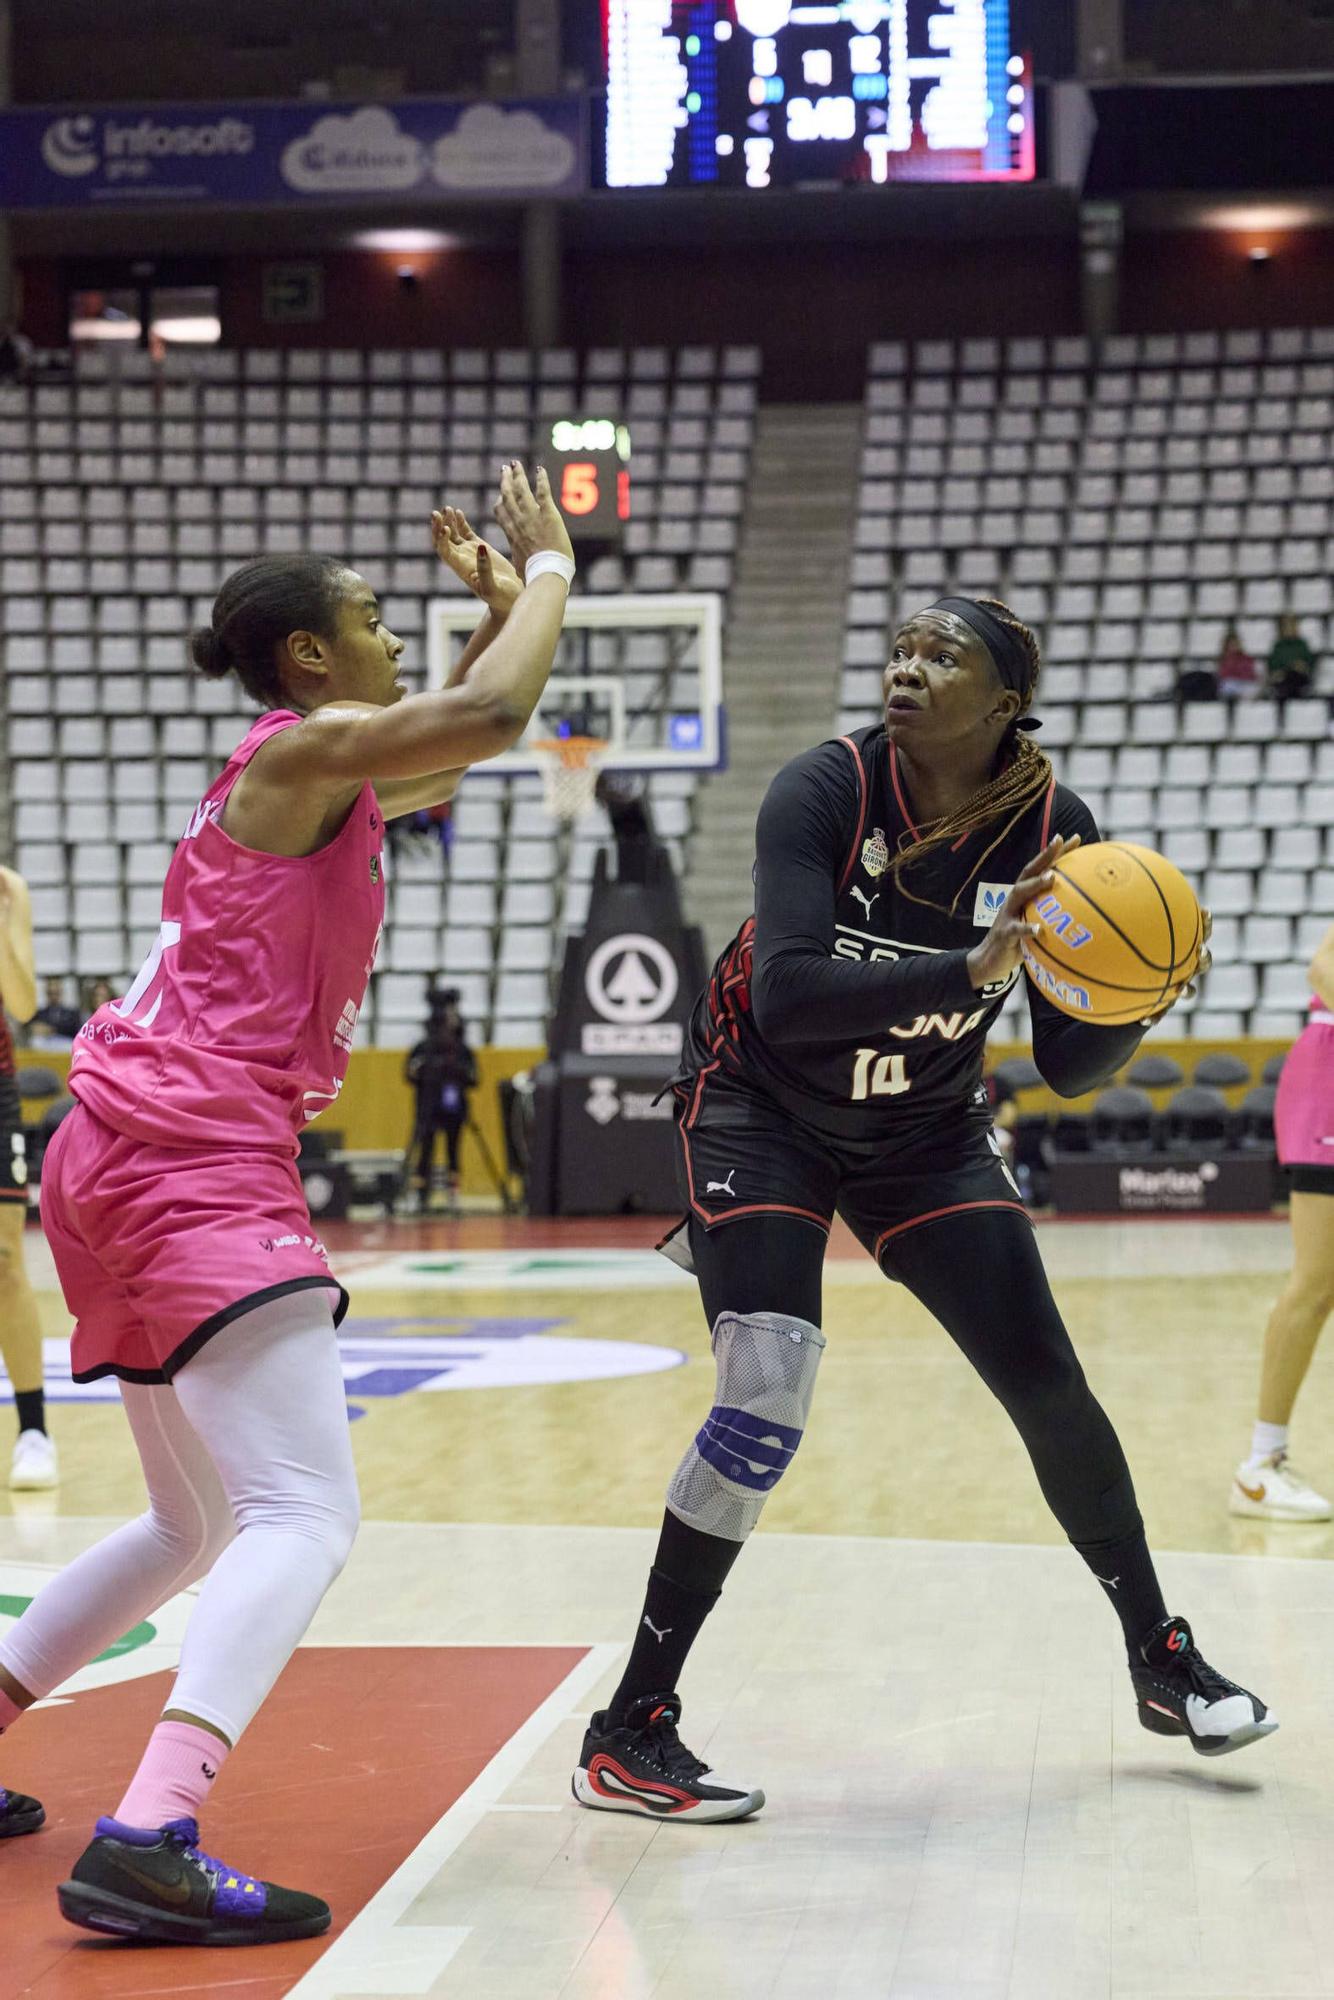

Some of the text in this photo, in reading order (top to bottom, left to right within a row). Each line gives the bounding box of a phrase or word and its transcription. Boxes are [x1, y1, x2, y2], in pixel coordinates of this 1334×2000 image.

[104, 117, 254, 154] infosoft
[560, 463, 599, 515] 5
[851, 1048, 911, 1100] 14
